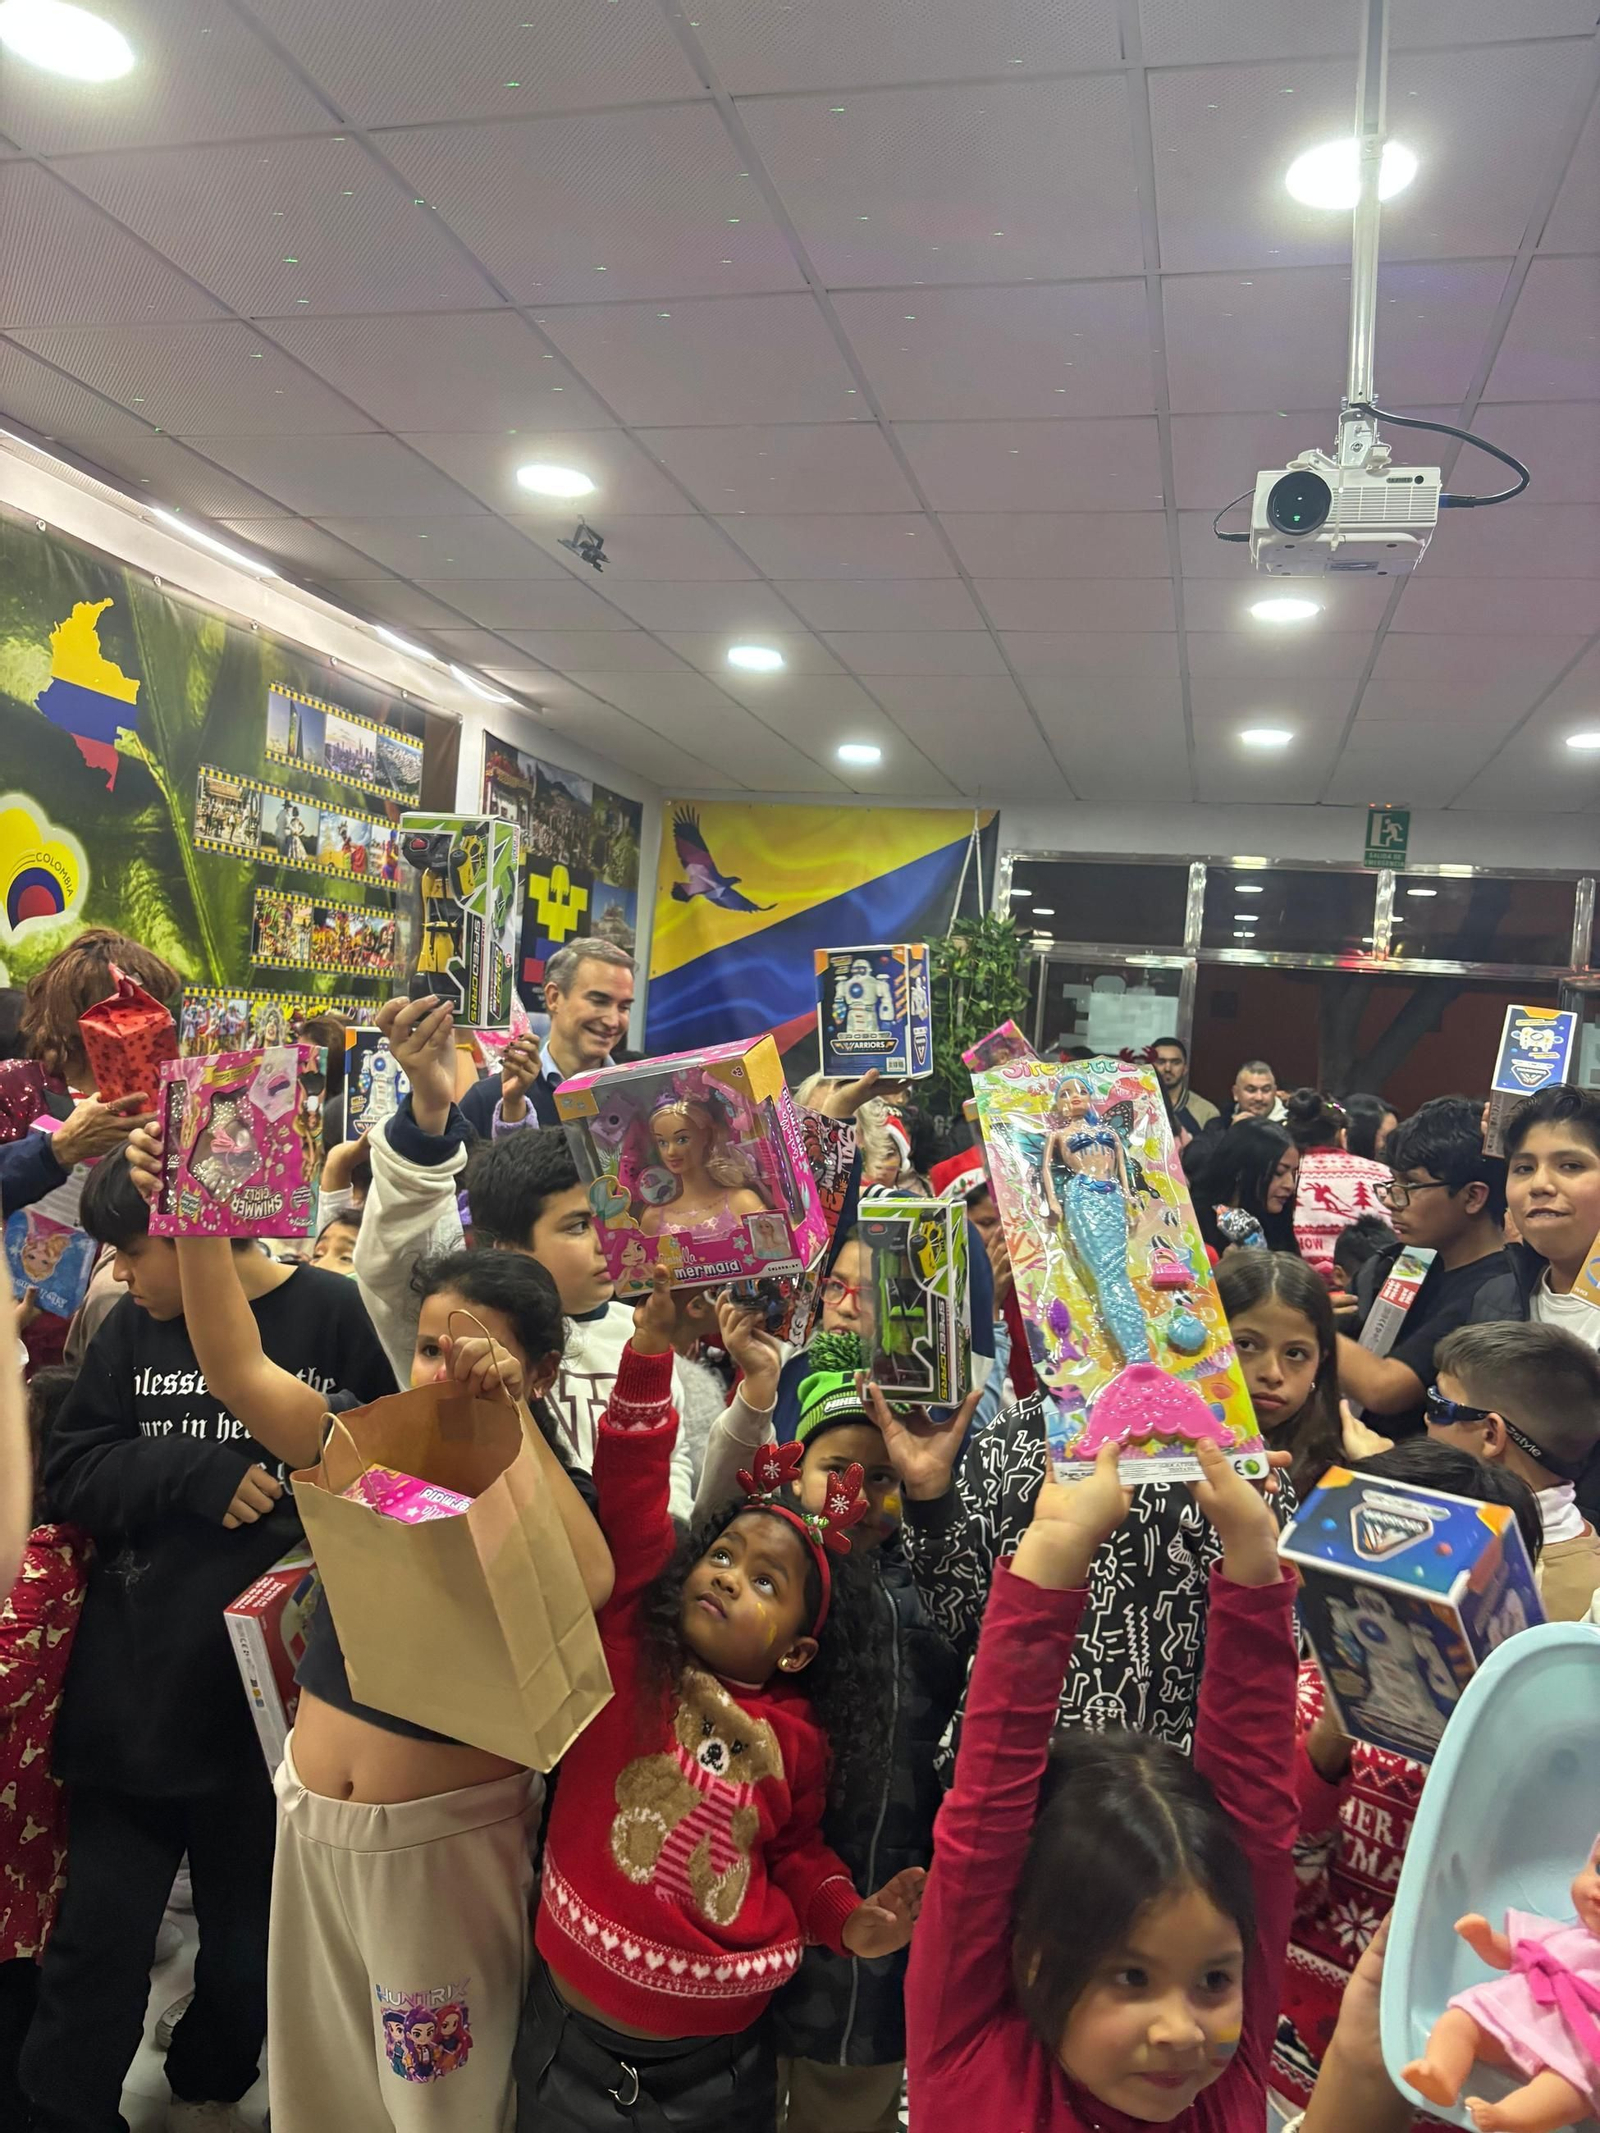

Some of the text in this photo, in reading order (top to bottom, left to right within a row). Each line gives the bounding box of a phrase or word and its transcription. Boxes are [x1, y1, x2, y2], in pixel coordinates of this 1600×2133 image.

[1369, 852, 1391, 860] SALIDA
[35, 852, 74, 897] COLOMBIA
[842, 1041, 885, 1051] WARRIORS
[231, 1191, 284, 1220] SHIMMER
[674, 1260, 742, 1281] mermaid
[182, 1412, 208, 1440] in
[420, 1486, 471, 1512] ermaid
